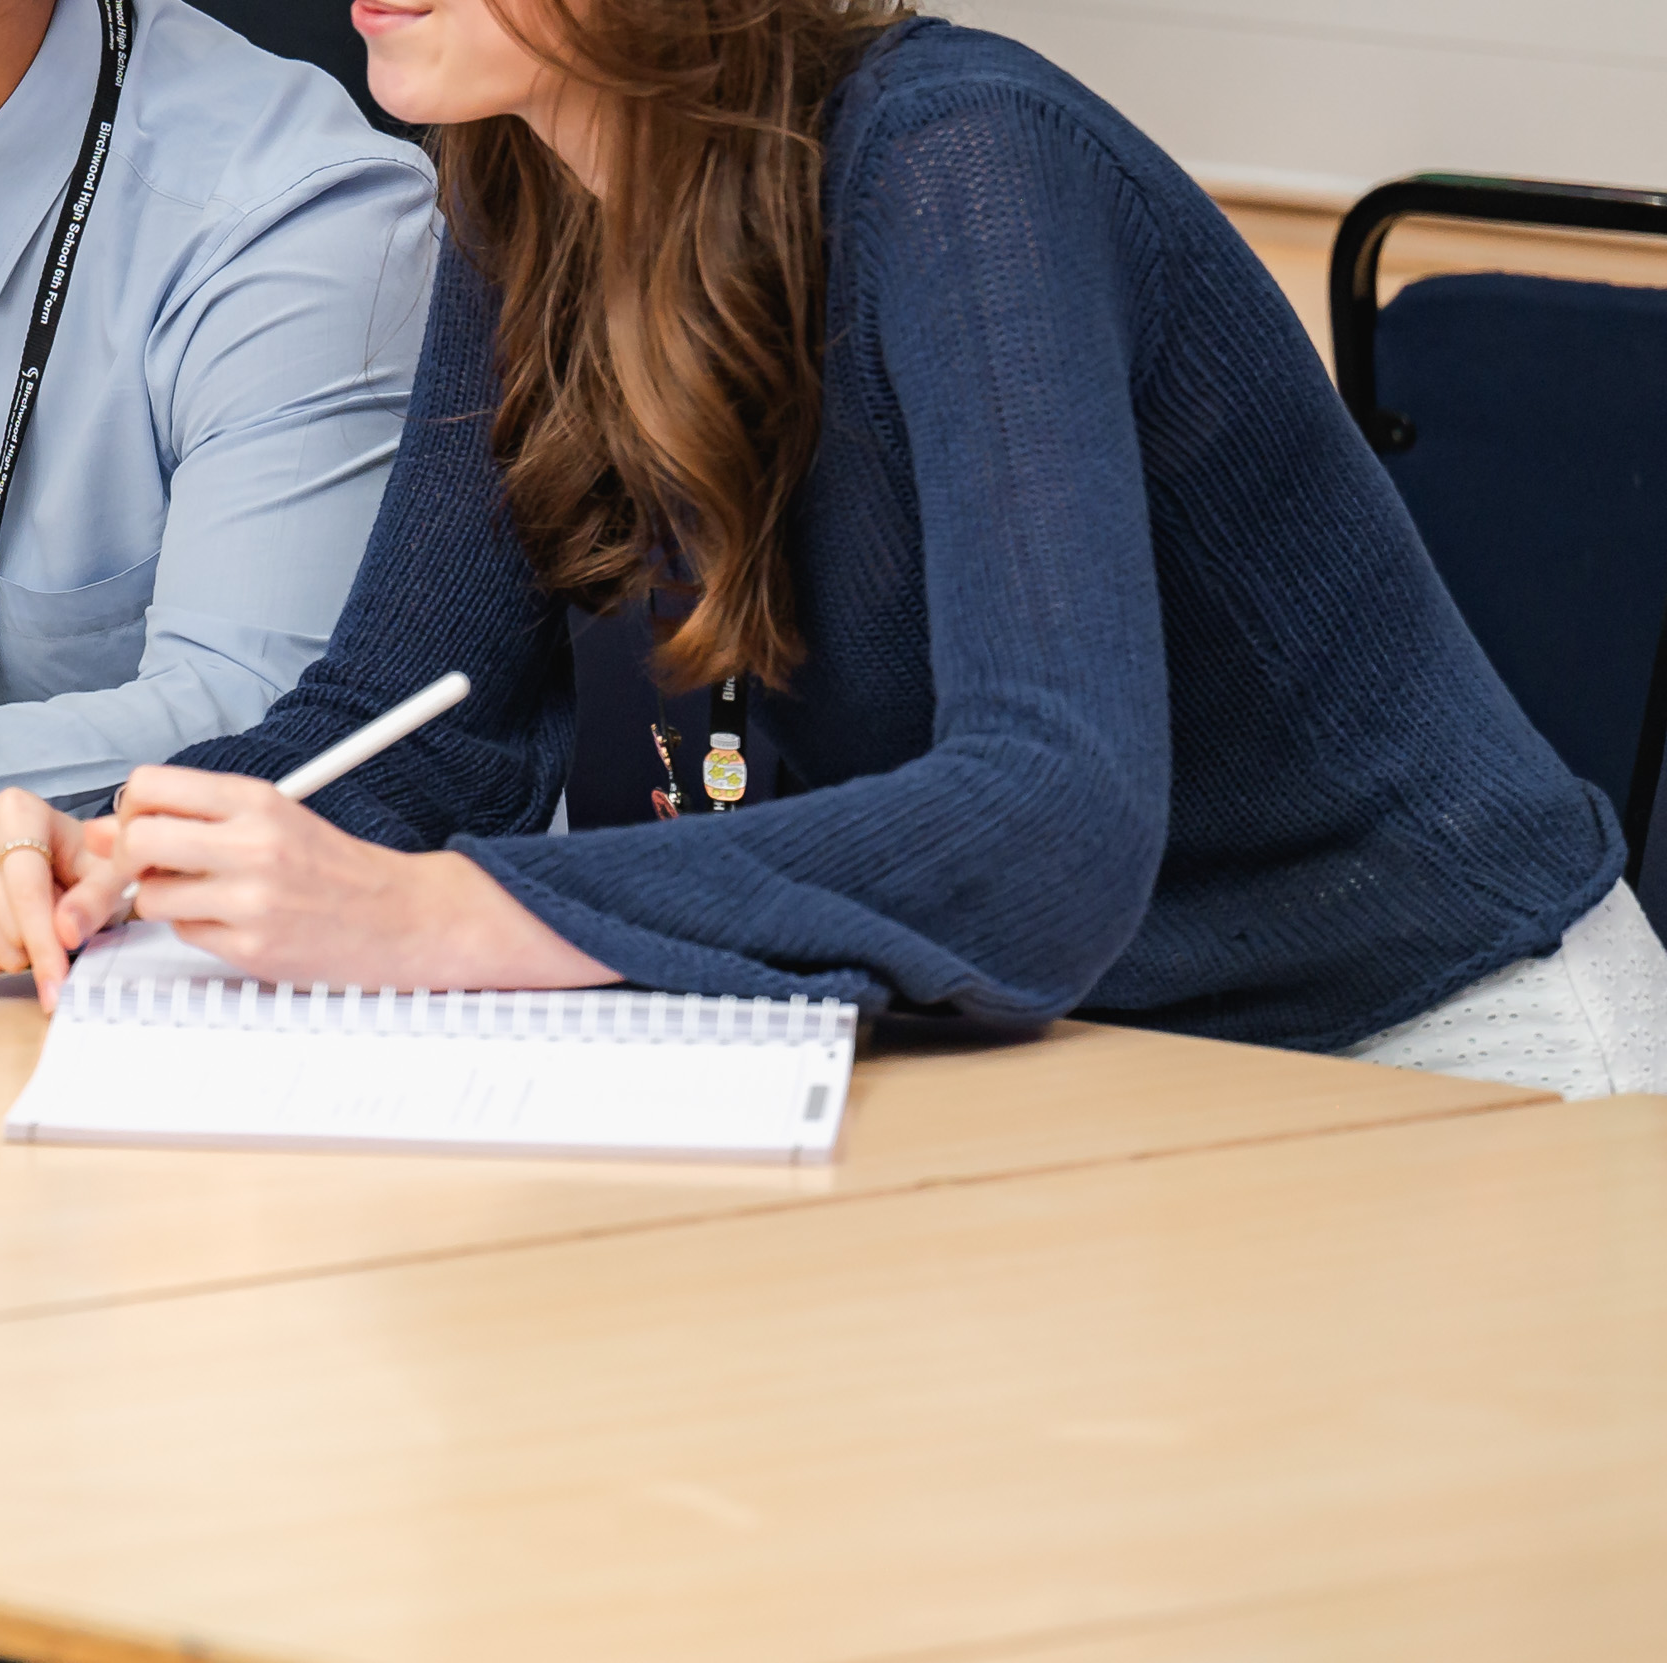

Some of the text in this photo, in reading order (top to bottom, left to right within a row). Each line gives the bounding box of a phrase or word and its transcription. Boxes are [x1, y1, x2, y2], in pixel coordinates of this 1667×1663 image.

[117, 27, 127, 50] High
[114, 51, 127, 88] School
[40, 121, 112, 325] Birchwood High School 6th Form
[11, 381, 34, 443] Birchwood
[3, 444, 16, 471] High
